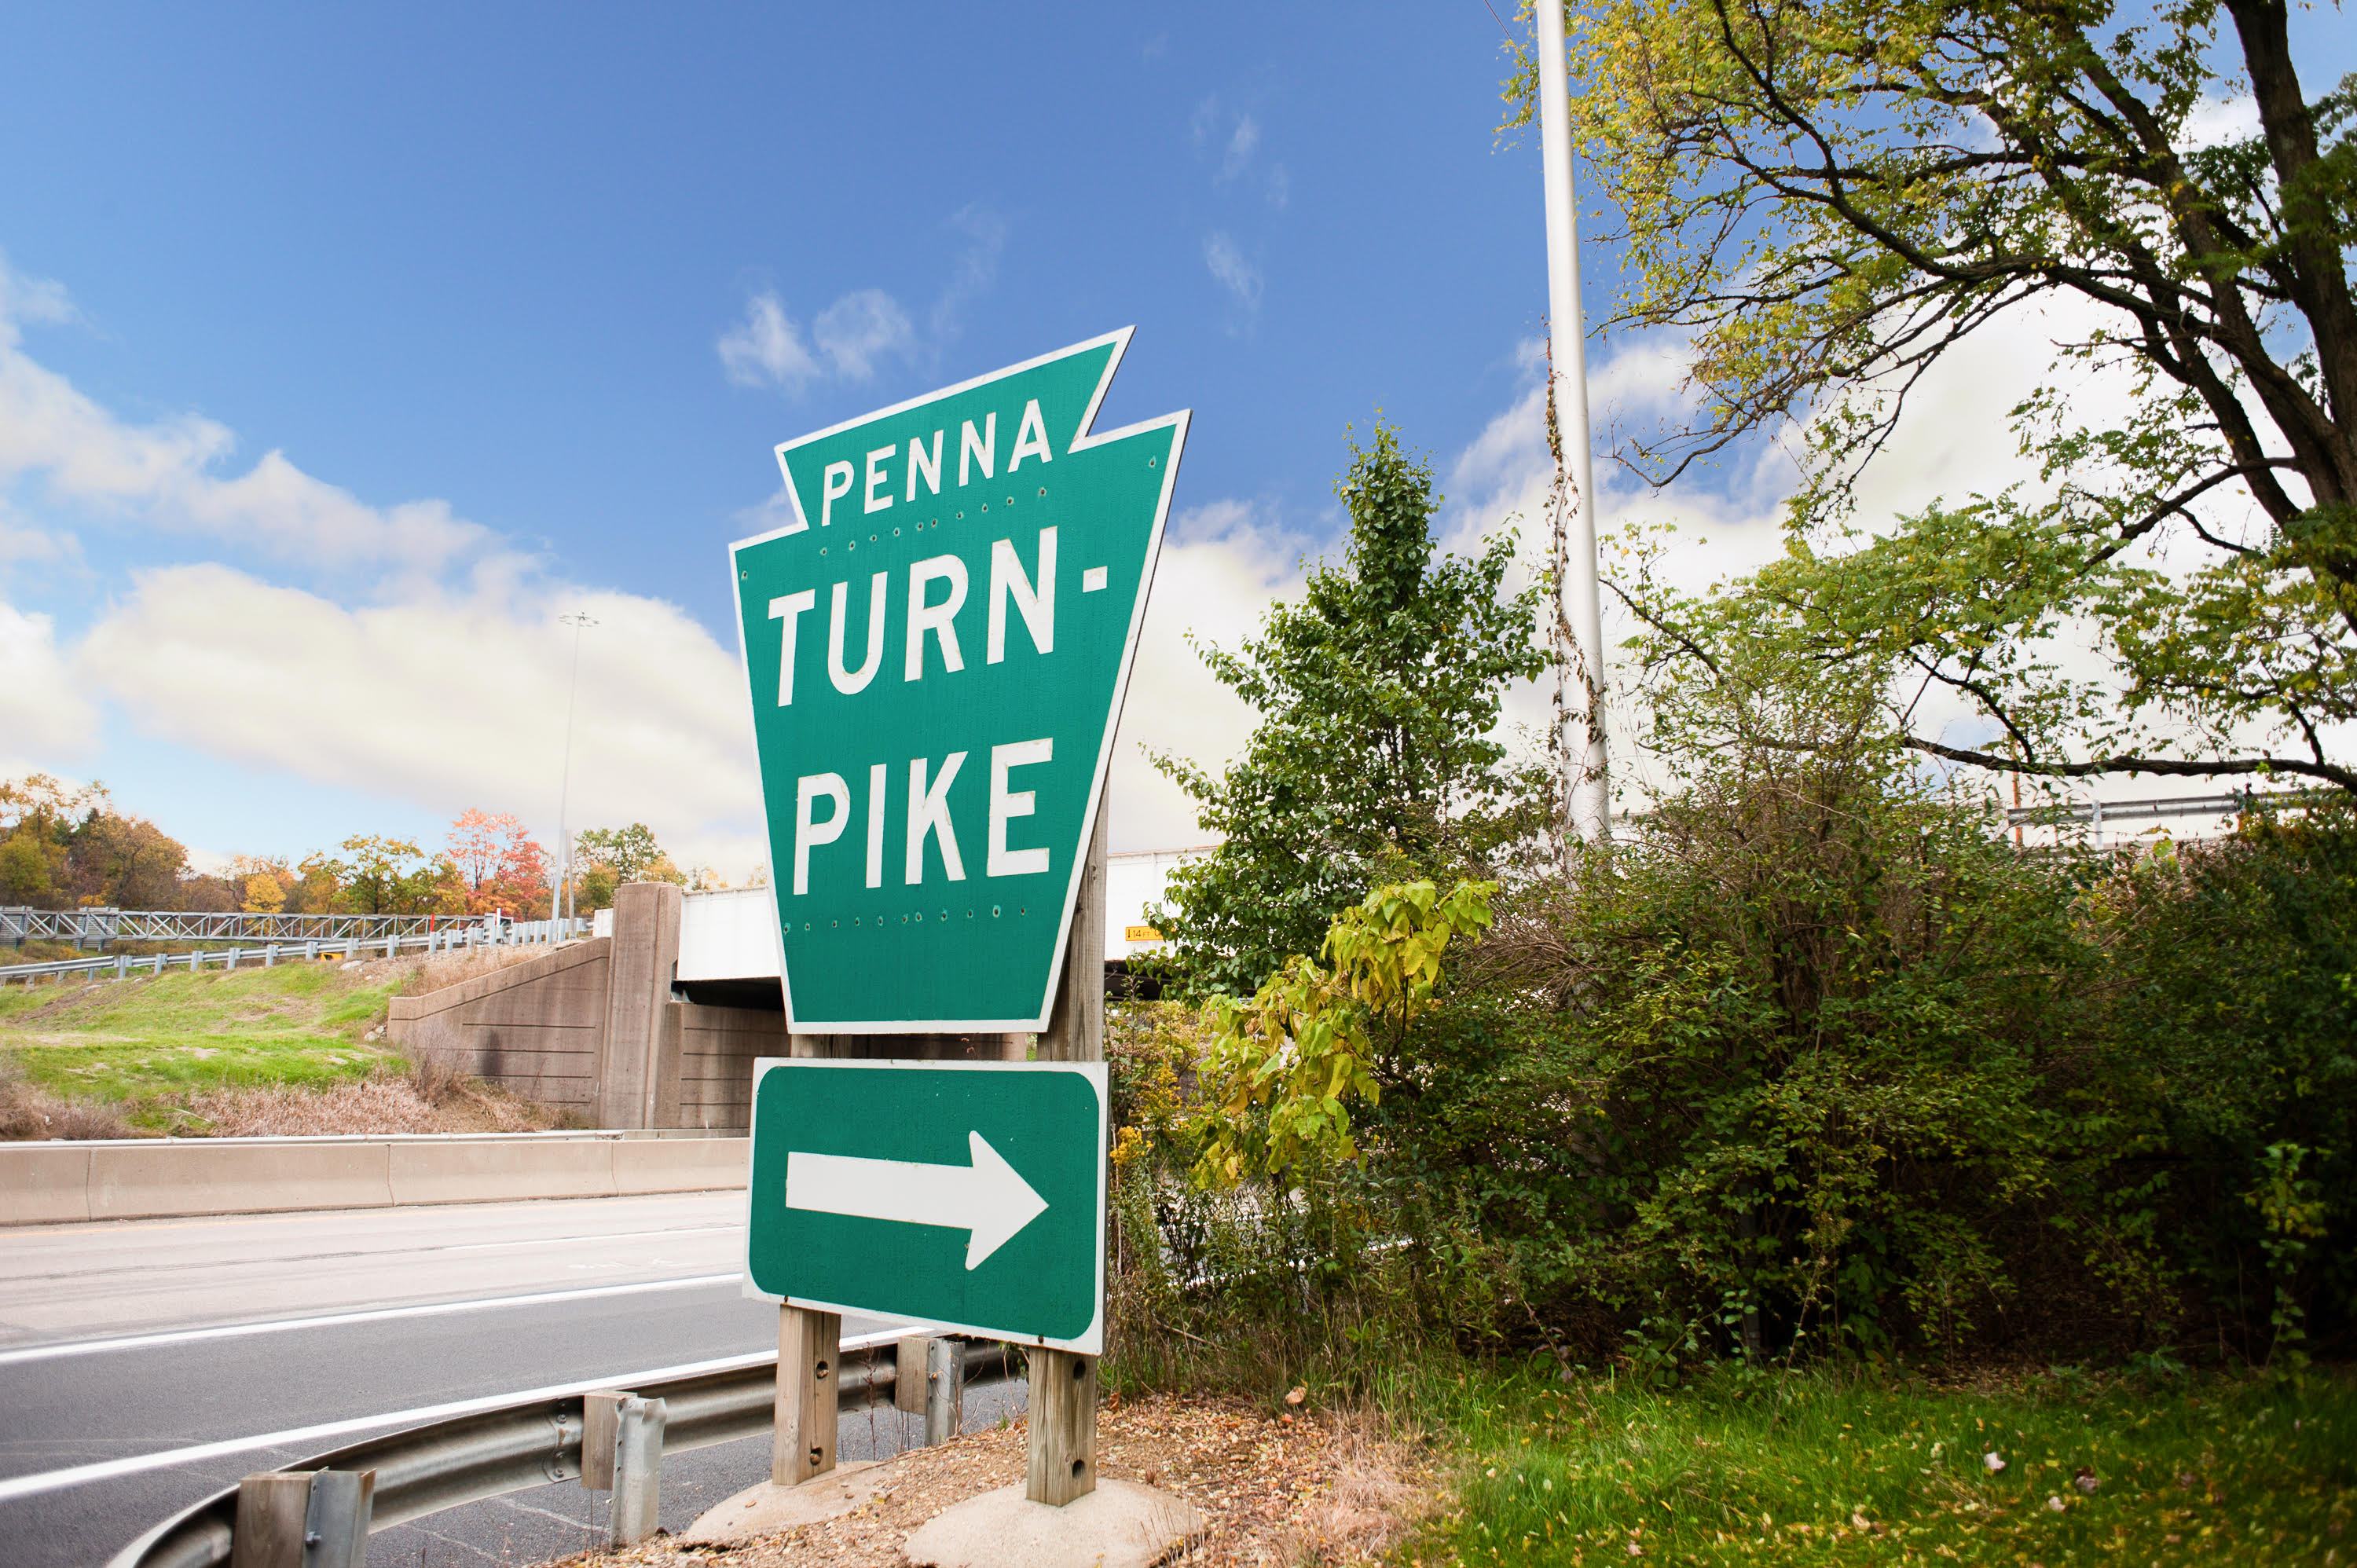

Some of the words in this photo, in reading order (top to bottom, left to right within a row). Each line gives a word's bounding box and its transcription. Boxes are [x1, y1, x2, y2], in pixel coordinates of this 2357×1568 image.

[821, 398, 1053, 527] PENNA
[768, 526, 1108, 707] TURN-
[793, 737, 1054, 896] PIKE
[1133, 929, 1142, 938] 14
